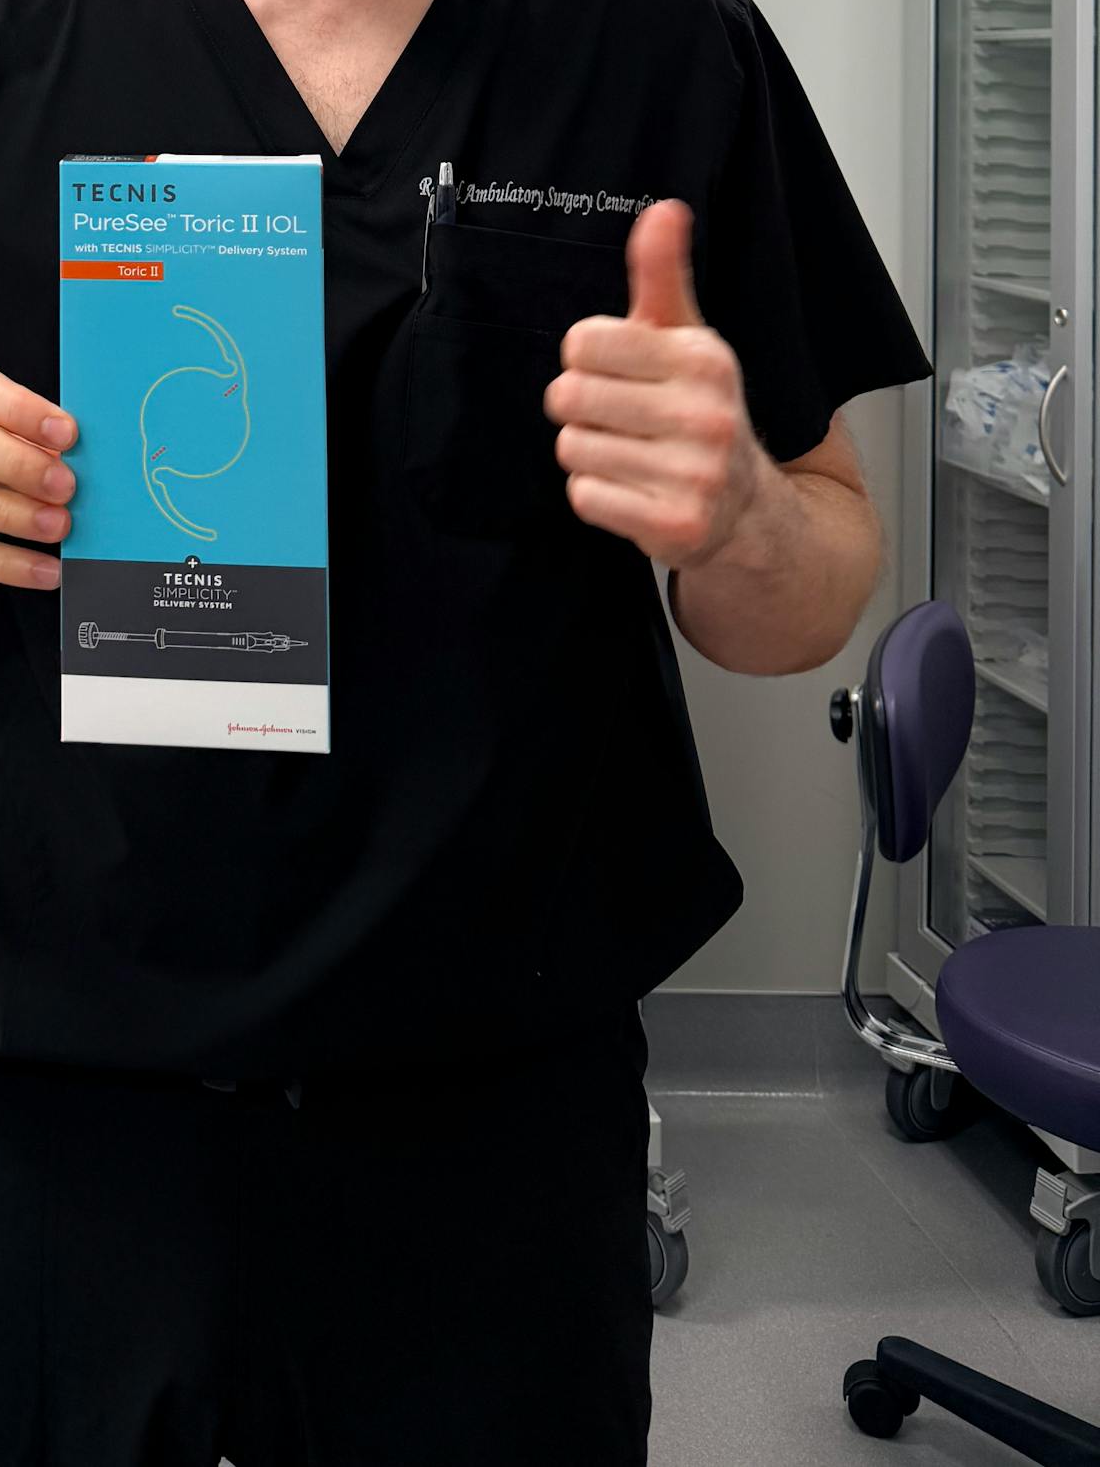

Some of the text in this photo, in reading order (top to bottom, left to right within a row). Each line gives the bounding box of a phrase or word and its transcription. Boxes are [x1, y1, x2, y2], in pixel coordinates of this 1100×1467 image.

[72, 183, 177, 203] TECNIS
[461, 181, 544, 211] Ambulatory
[545, 186, 593, 216] Surgery
[596, 190, 635, 214] Center
[180, 214, 236, 233] Toric
[241, 214, 259, 233] II
[266, 215, 308, 234] IOL
[75, 244, 99, 254] with
[101, 244, 142, 254] TECNIS
[218, 245, 264, 257] Delivery
[267, 246, 308, 257] System
[118, 265, 159, 277] Toric II
[163, 573, 223, 587] TECNIS
[153, 600, 233, 610] DELIVERY SYSTEM
